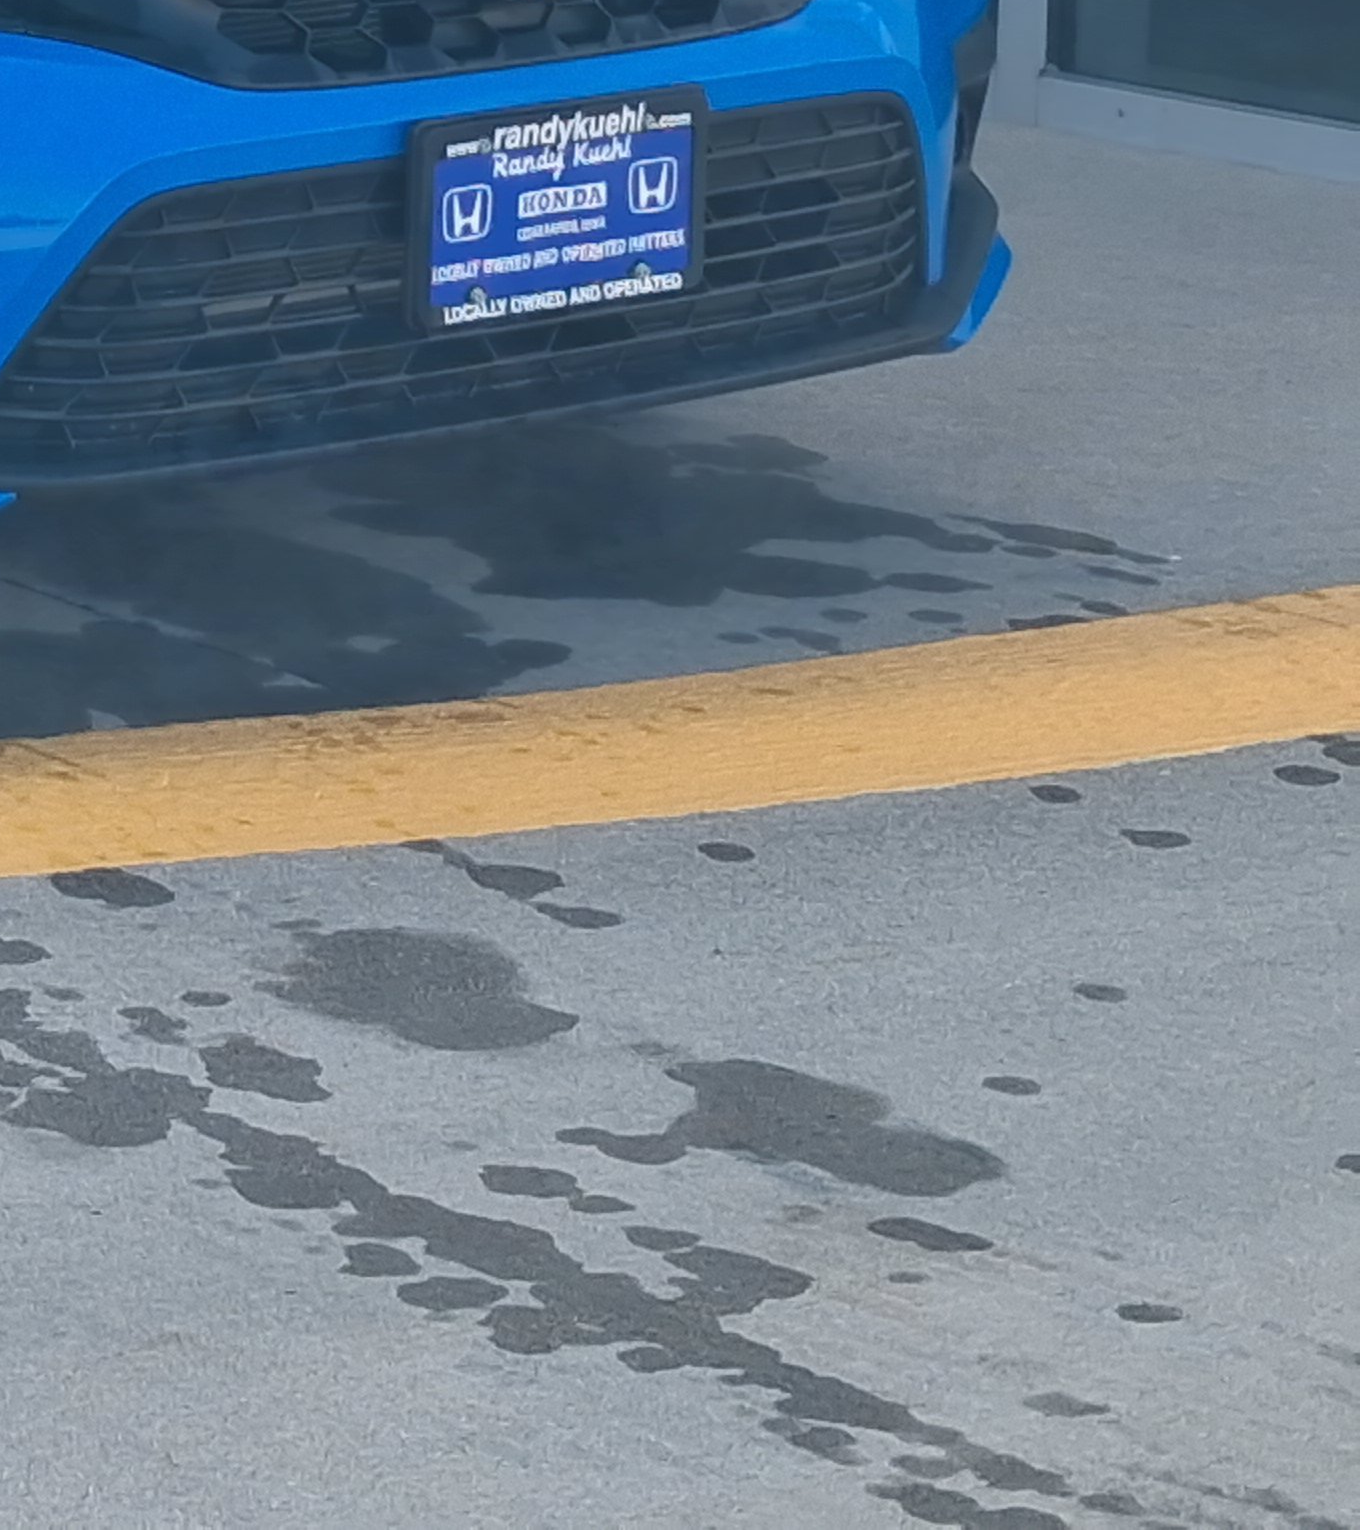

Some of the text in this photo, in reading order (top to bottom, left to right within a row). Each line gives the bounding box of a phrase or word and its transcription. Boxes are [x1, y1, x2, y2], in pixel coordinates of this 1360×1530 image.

[492, 134, 632, 181] Randy Kuehl
[521, 186, 603, 213] HONDA
[443, 272, 683, 325] LOCALLY OWNED AND OPERATED
